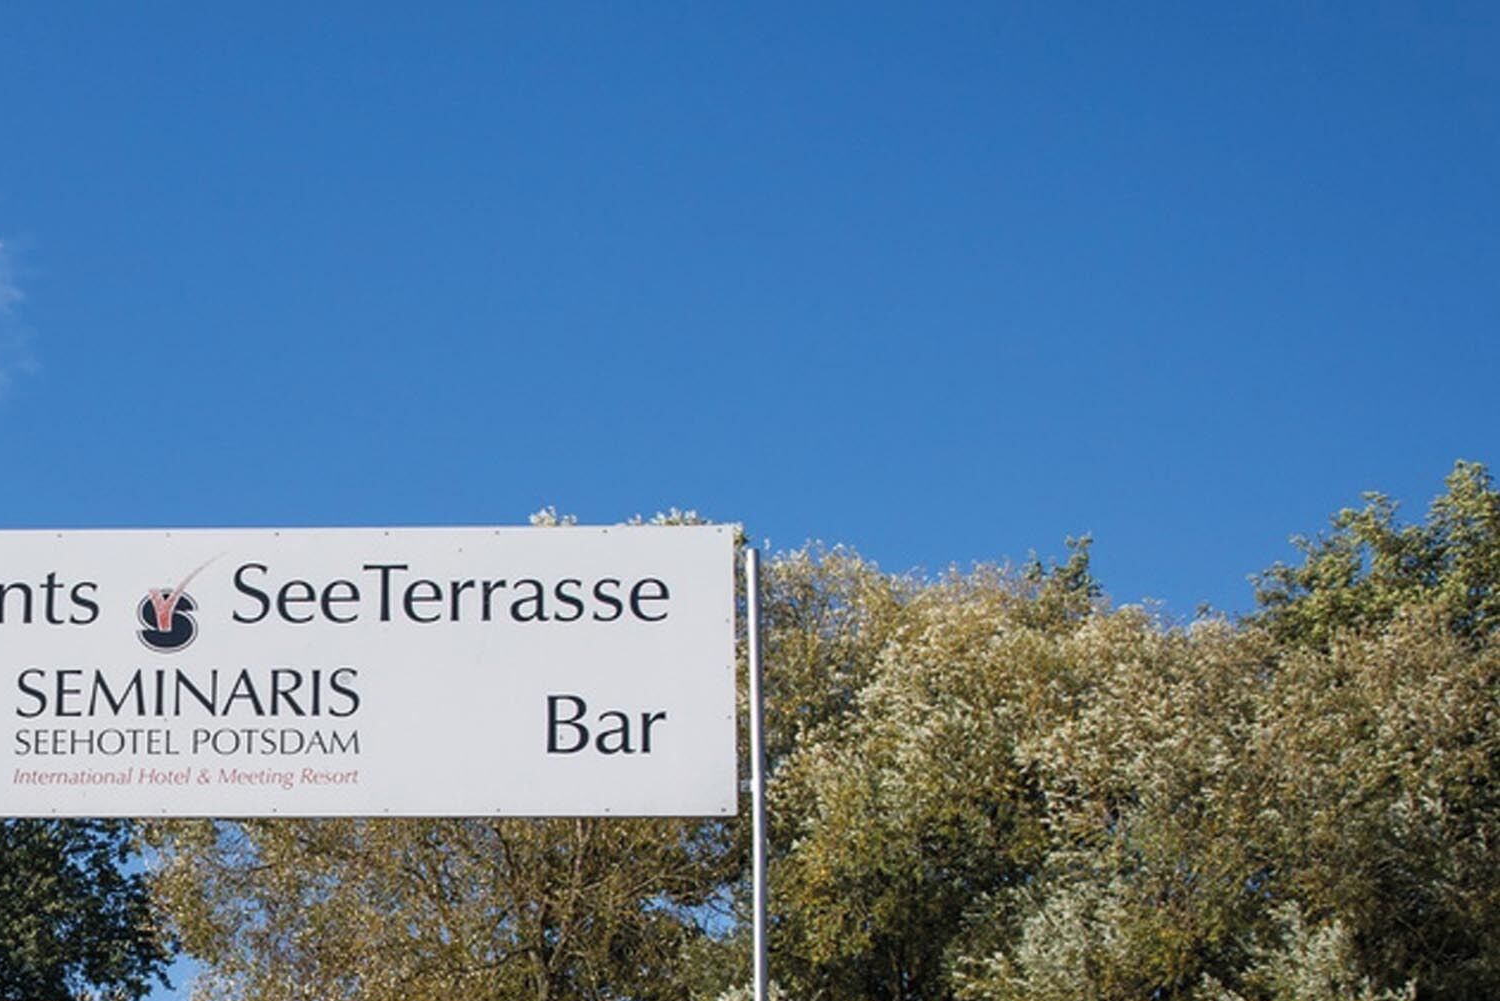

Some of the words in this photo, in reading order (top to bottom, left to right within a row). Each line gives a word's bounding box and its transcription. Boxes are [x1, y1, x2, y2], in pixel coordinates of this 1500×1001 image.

[231, 562, 671, 625] SeeTerrasse
[15, 667, 361, 717] SEMINARIS
[14, 728, 180, 756] SEEHOTEL
[192, 728, 361, 756] POTSDAM
[546, 694, 668, 756] Bar
[12, 767, 134, 786] International
[137, 767, 192, 786] Hotel
[196, 769, 211, 786] &
[218, 768, 294, 791] Meeting
[299, 767, 360, 786] Resort
